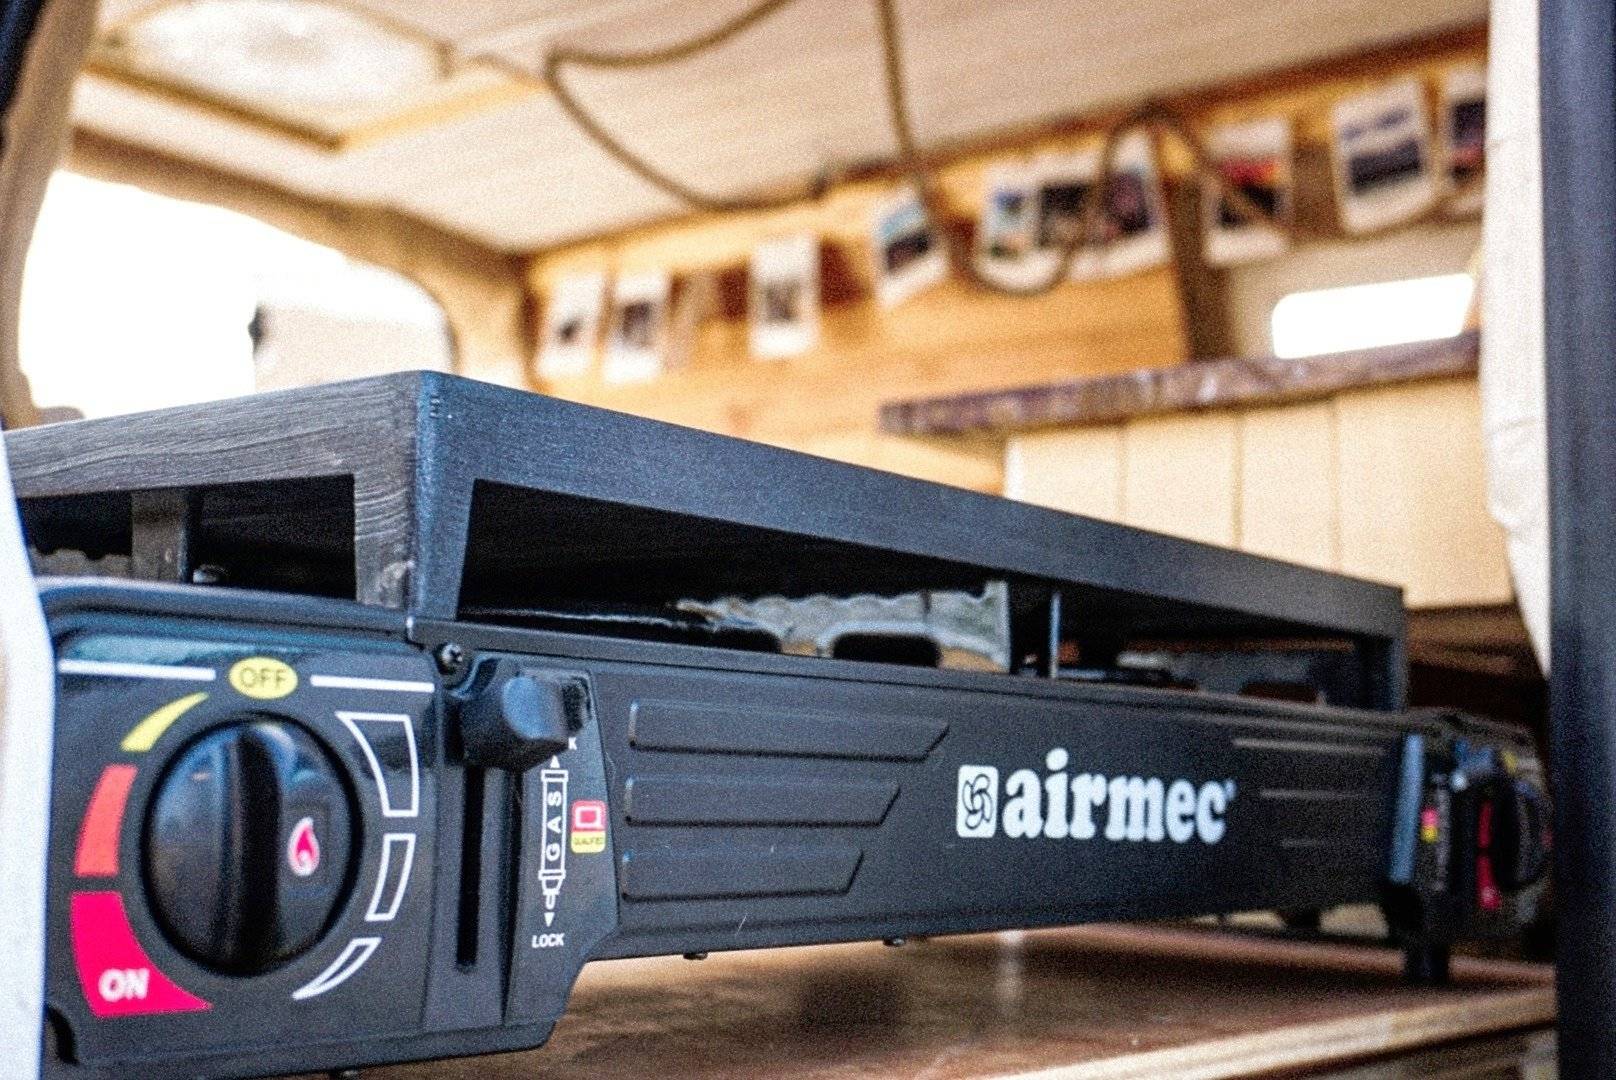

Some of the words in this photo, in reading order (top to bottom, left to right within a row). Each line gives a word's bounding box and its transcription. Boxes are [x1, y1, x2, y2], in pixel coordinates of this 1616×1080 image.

[241, 667, 288, 688] OFF
[1002, 748, 1227, 844] airmec
[547, 791, 562, 861] GAS
[532, 933, 565, 949] LOCK
[98, 968, 150, 1002] ON
